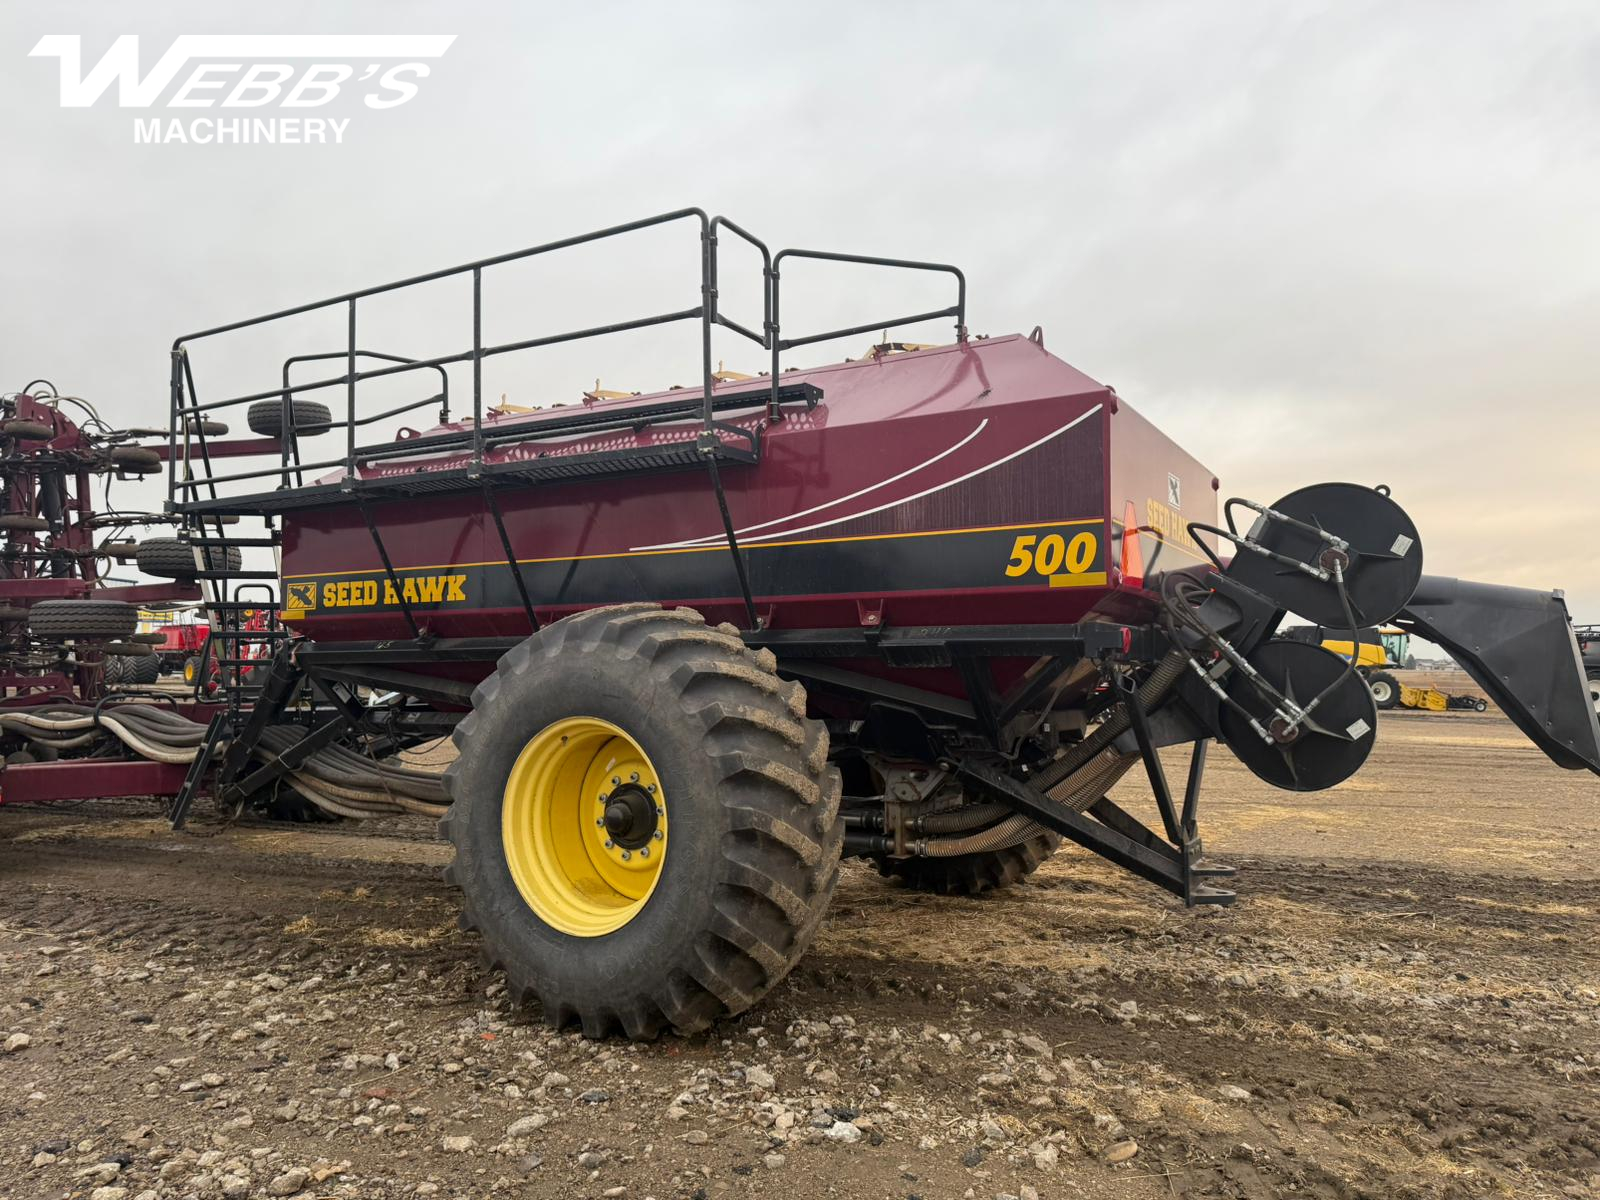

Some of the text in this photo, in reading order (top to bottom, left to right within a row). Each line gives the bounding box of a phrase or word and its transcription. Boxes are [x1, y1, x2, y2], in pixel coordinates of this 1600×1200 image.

[1147, 498, 1170, 537] SEED
[1004, 531, 1098, 578] 500
[323, 574, 468, 609] SEED HAWK
